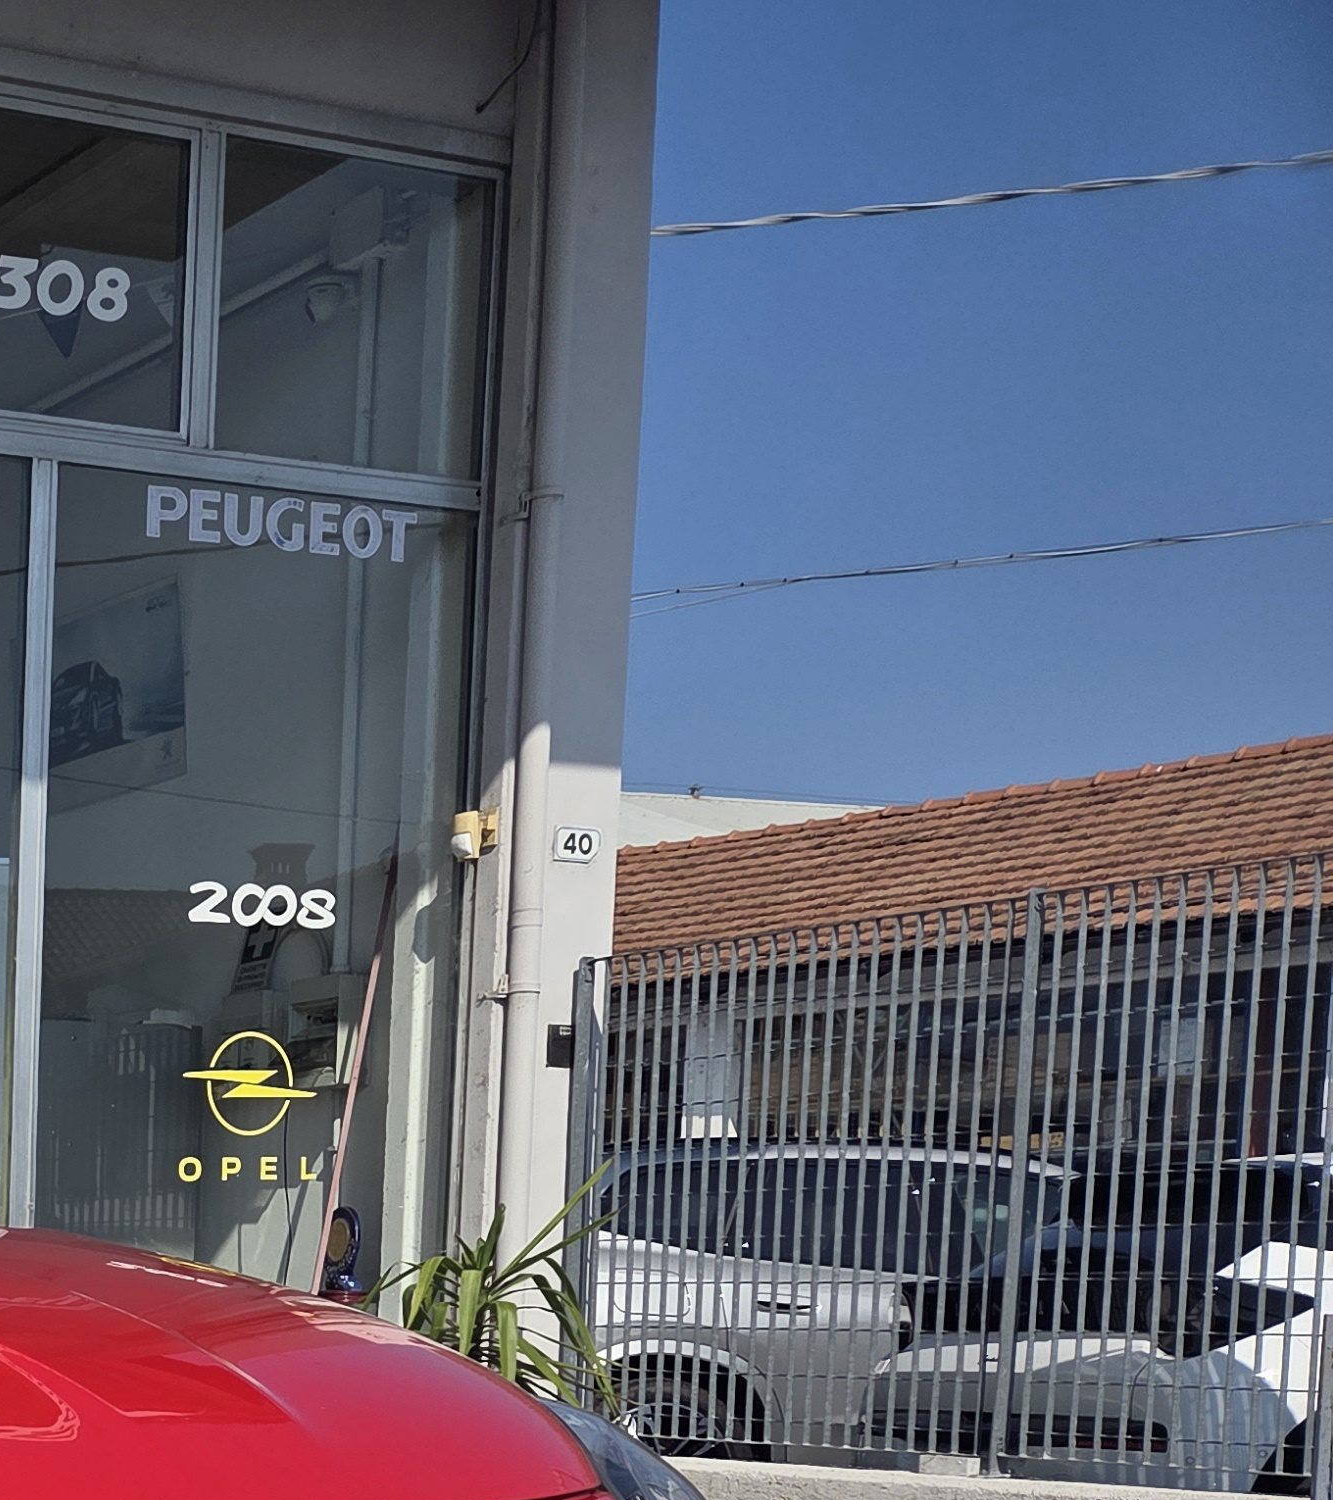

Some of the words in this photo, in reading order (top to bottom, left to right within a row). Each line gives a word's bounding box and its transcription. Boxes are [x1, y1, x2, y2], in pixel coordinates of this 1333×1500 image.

[146, 485, 417, 563] PEUGEOT
[563, 832, 593, 856] 40
[188, 881, 336, 929] 2008
[178, 1155, 317, 1181] OPEL
